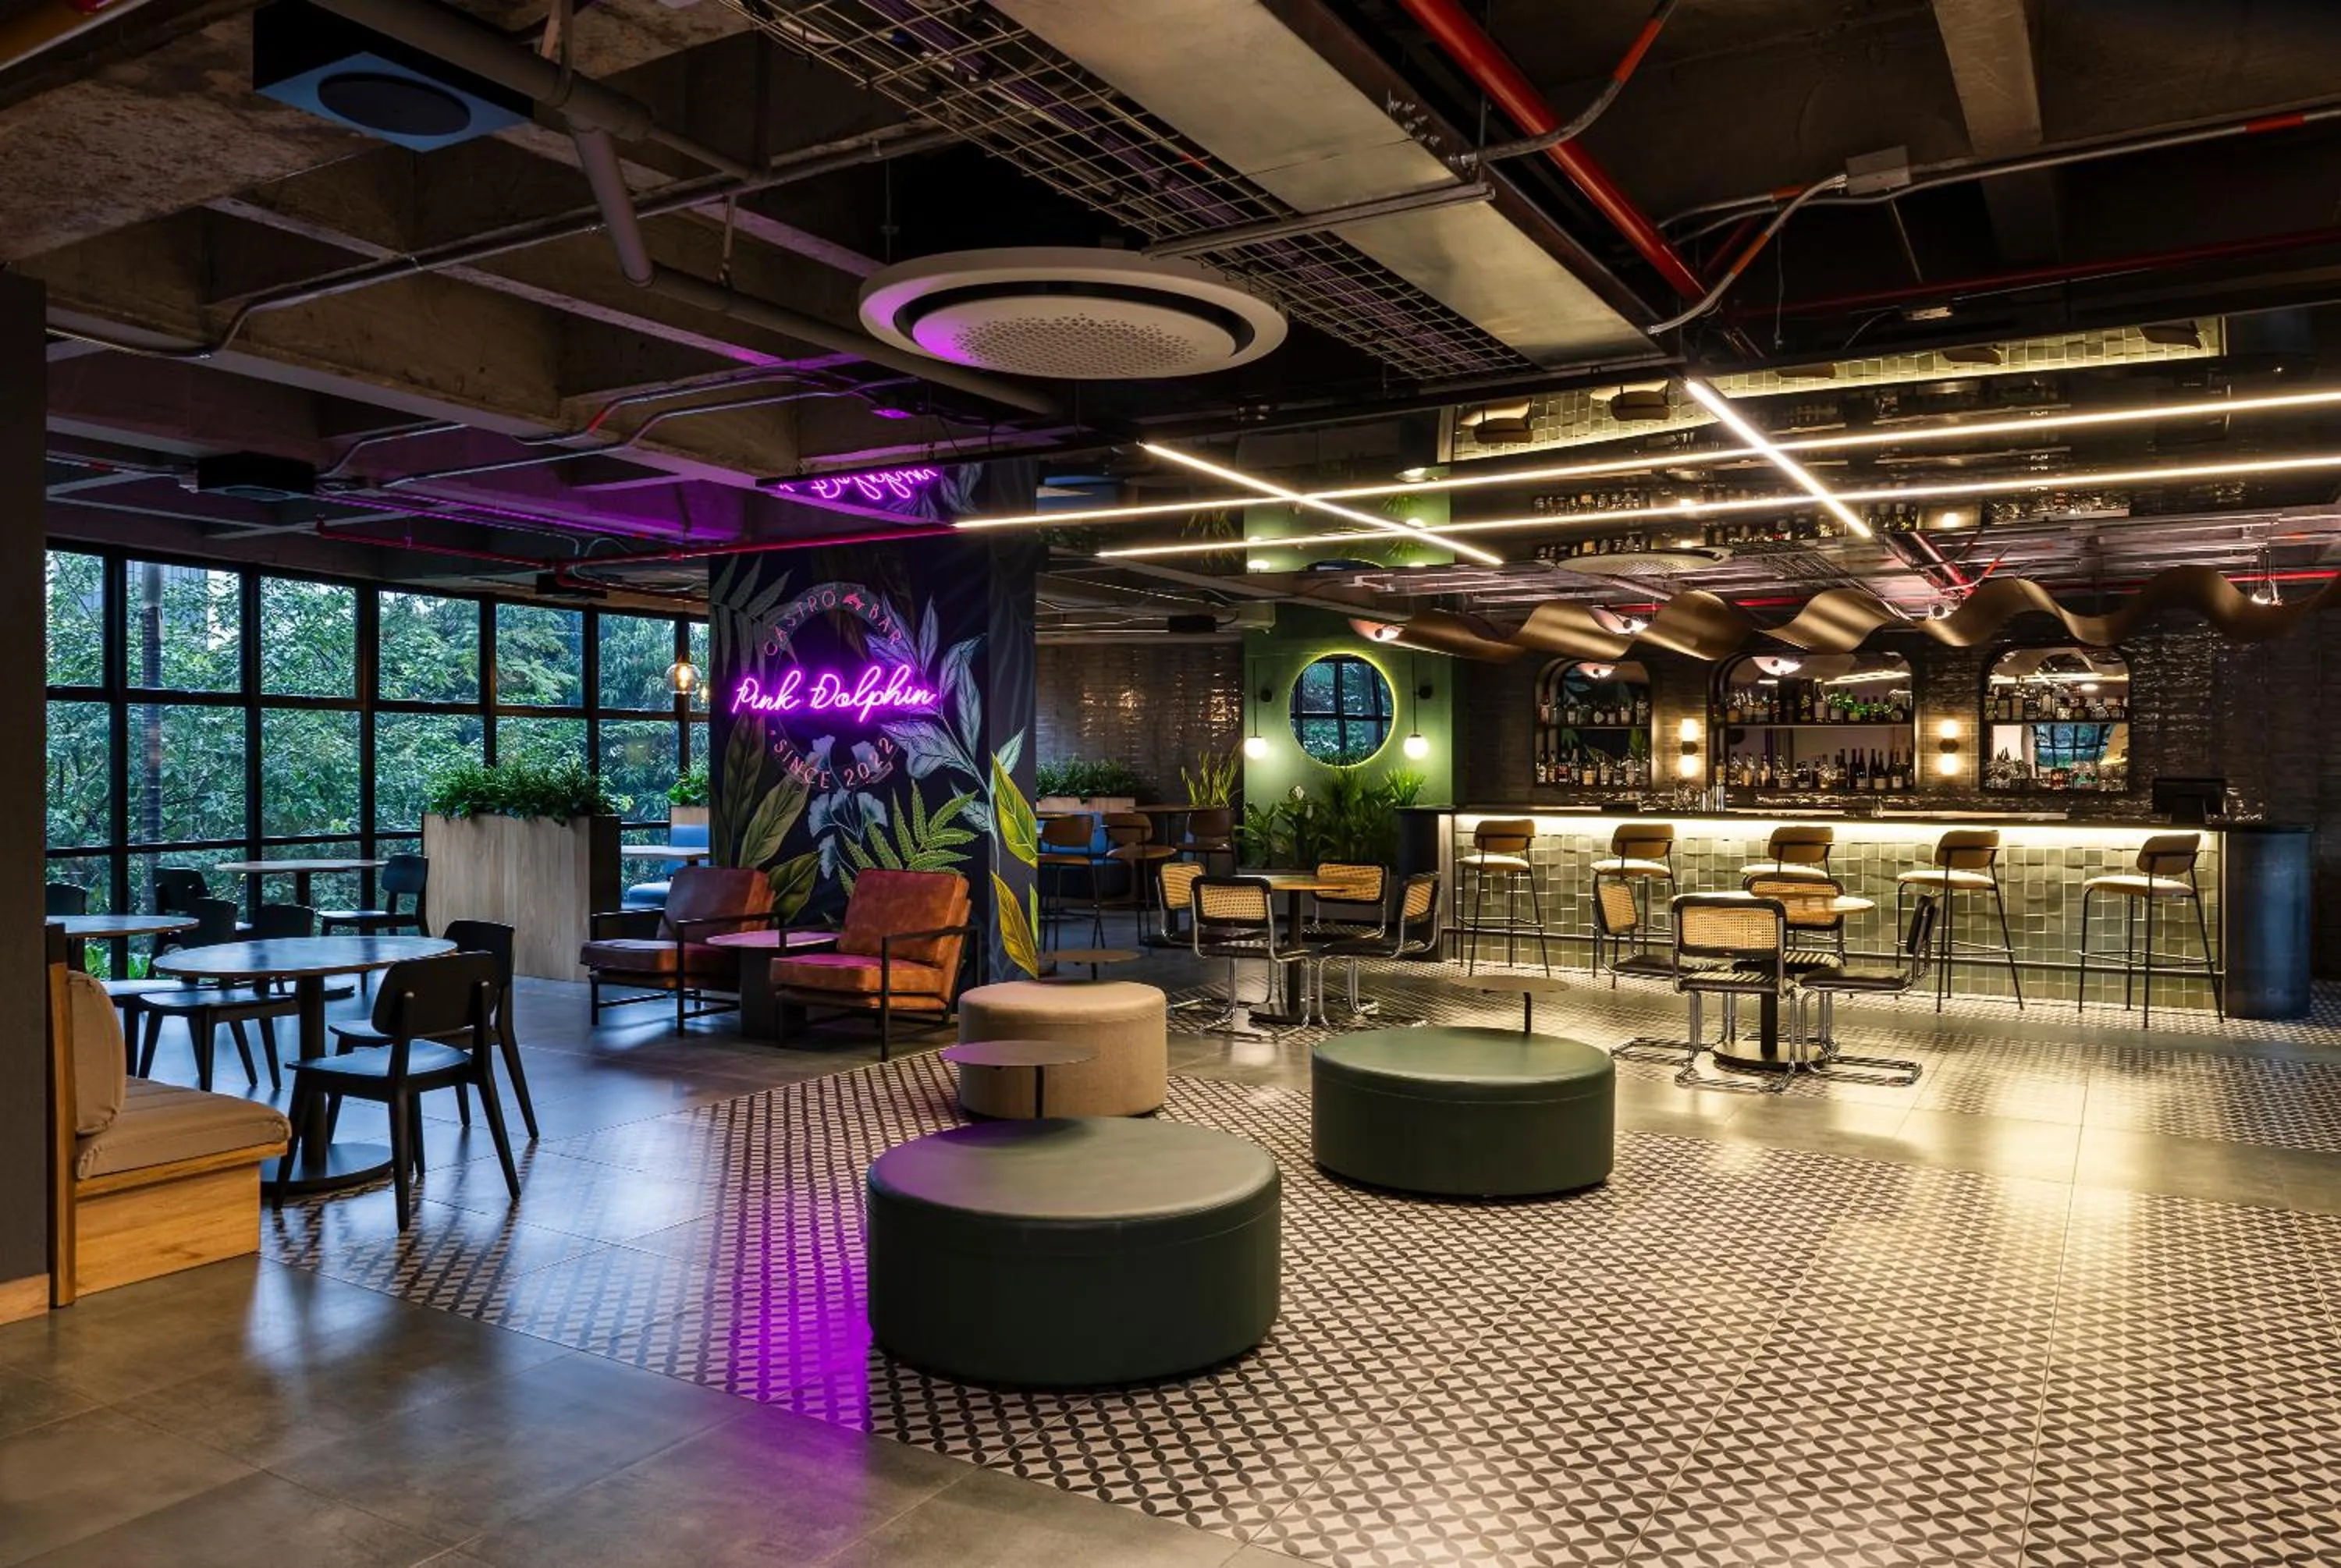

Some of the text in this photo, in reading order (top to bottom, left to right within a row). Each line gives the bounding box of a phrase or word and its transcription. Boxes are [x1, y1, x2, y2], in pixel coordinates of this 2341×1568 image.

[869, 602, 902, 645] BAR
[732, 665, 937, 723] Pink Dolphin
[773, 737, 893, 789] SINCE 2022
